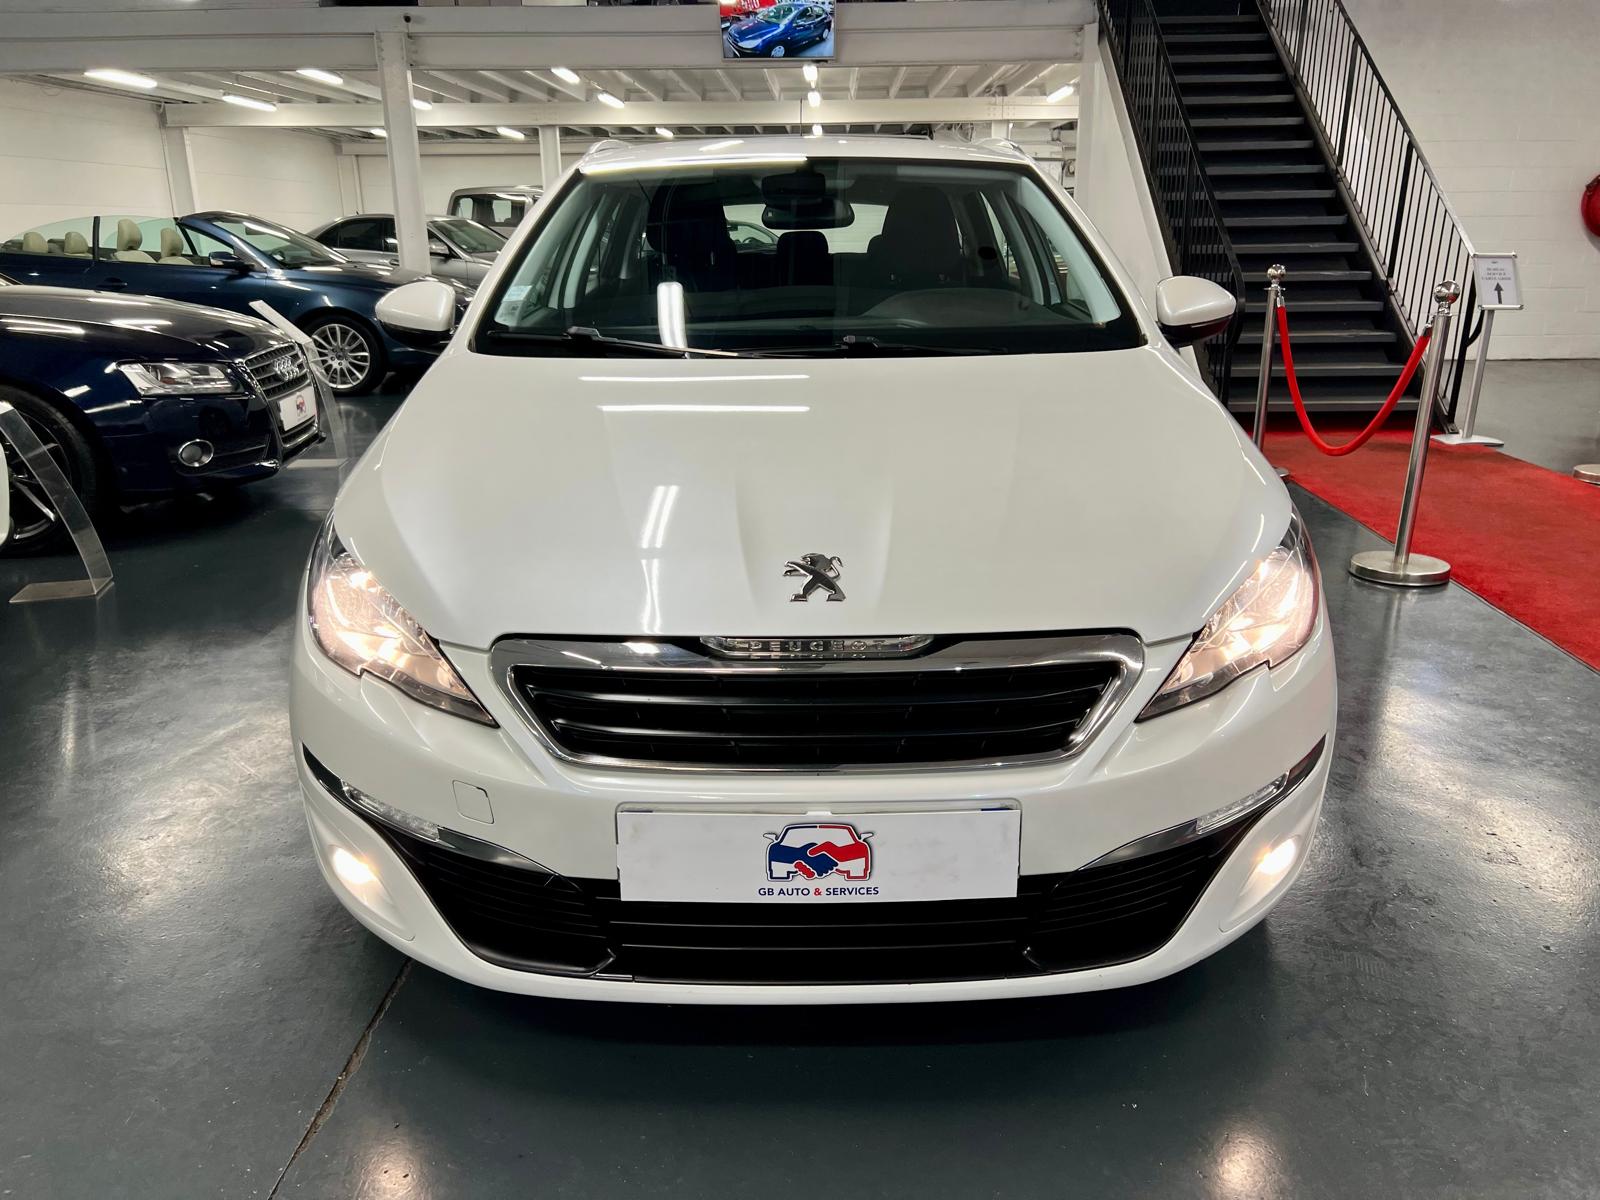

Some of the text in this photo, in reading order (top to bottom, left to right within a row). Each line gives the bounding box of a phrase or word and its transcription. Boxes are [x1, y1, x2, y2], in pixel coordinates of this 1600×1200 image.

[750, 639, 887, 651] PEUGEOT
[758, 886, 879, 896] GB AUTO & SERVICES
